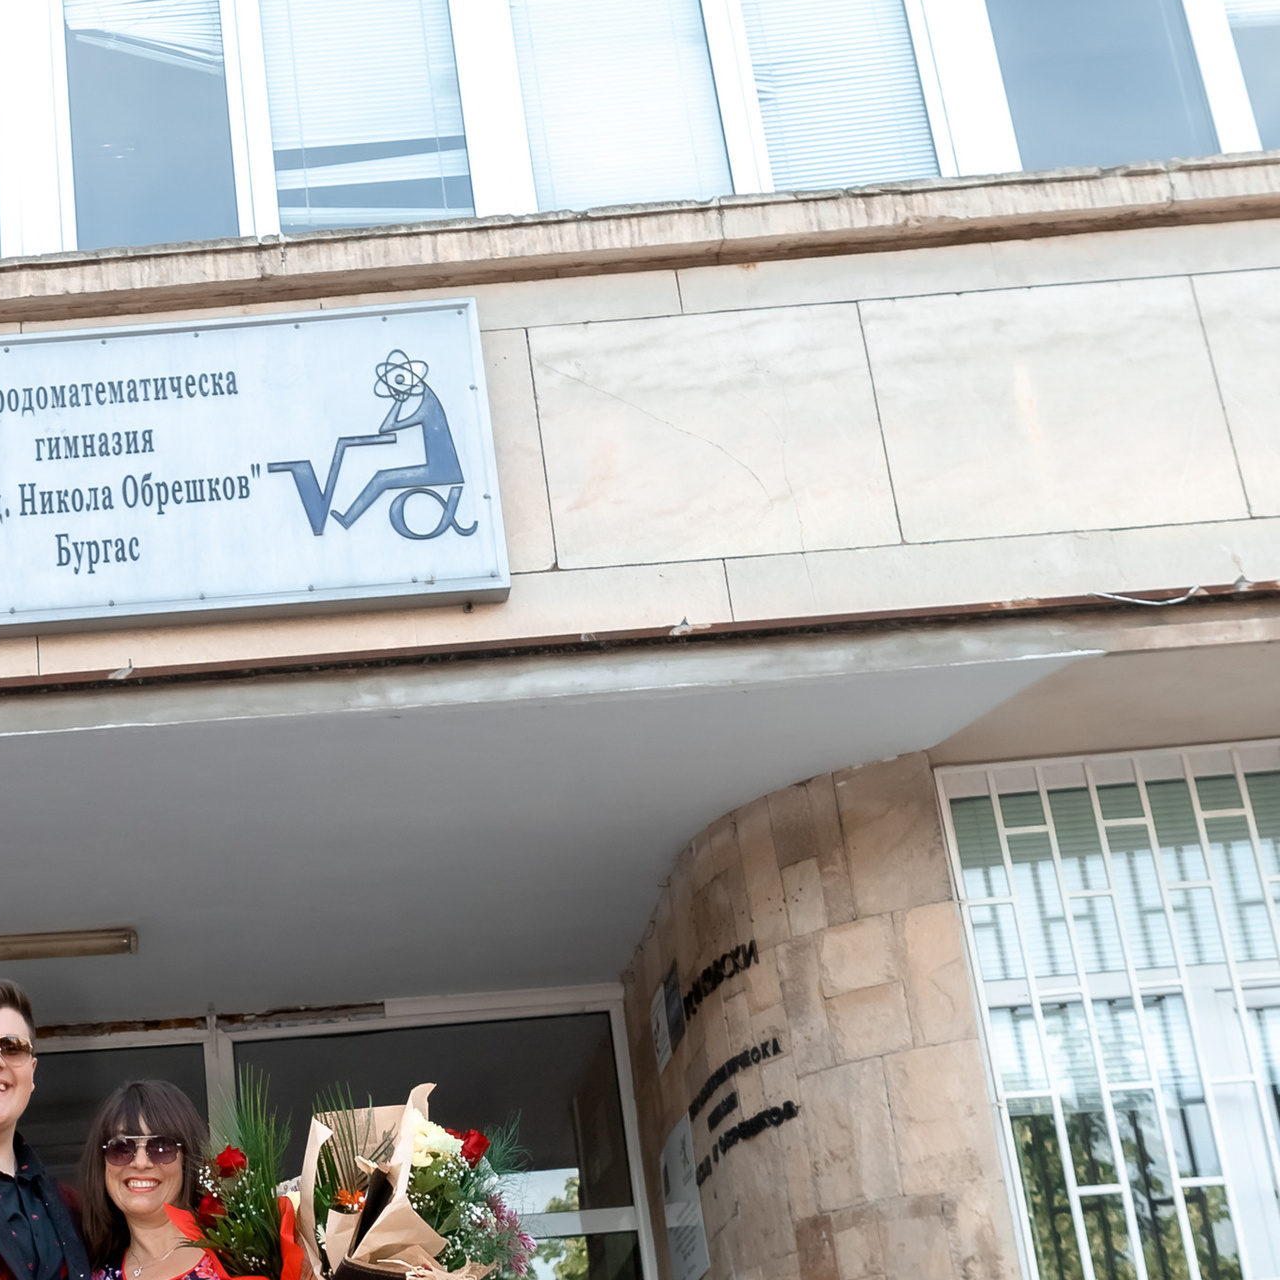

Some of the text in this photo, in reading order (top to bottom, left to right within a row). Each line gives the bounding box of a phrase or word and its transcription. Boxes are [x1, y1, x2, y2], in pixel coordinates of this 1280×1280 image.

[34, 429, 155, 462] гимназия
[18, 482, 114, 517] Никола
[122, 463, 262, 515] Обрешков"
[55, 533, 141, 575] Бургас
